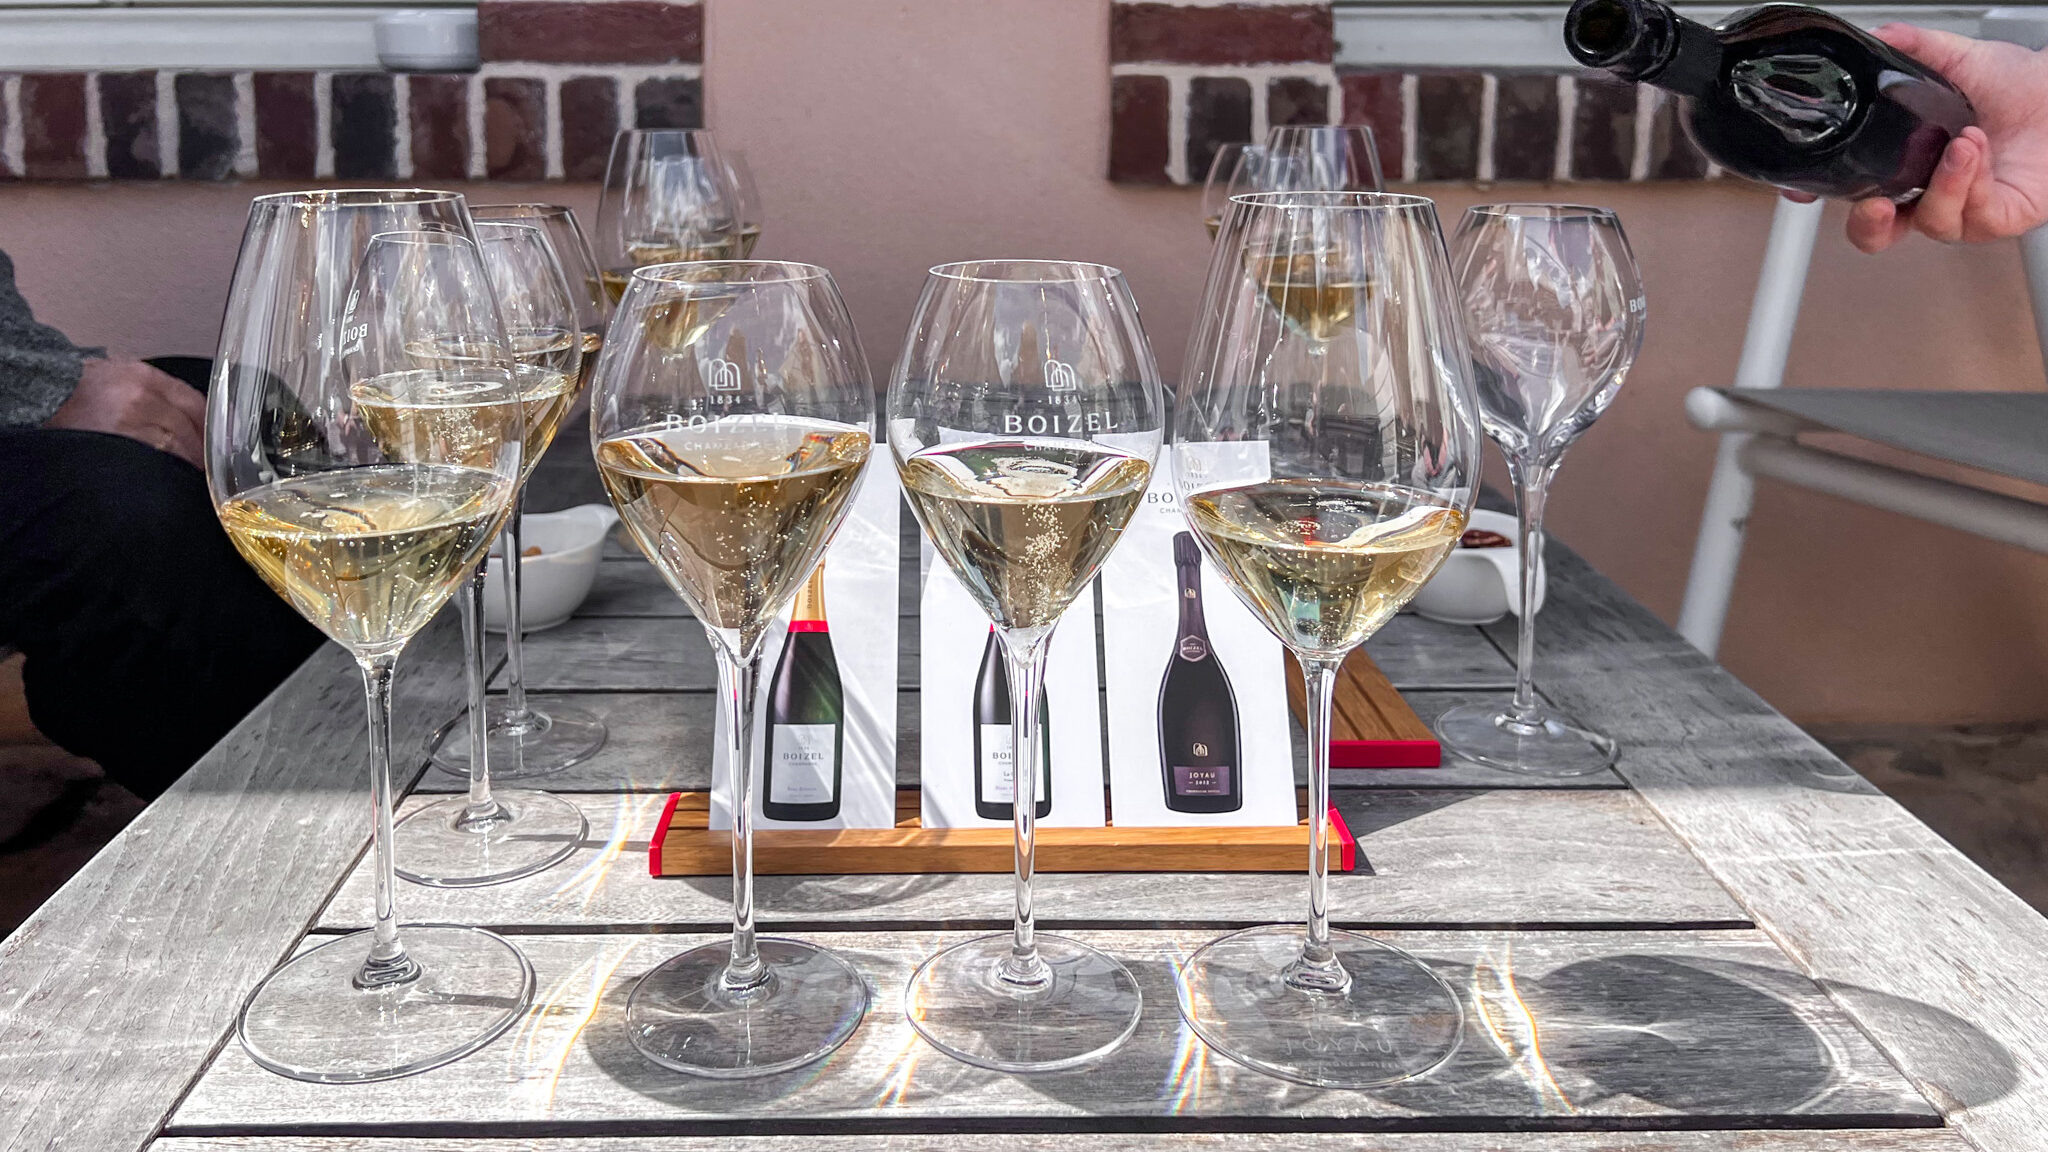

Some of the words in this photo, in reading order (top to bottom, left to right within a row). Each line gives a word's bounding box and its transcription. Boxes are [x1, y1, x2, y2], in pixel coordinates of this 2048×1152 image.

[666, 412, 788, 434] BOIZEL
[1004, 411, 1118, 434] BOIZEL
[783, 752, 824, 760] BOIZEL
[992, 752, 1012, 760] BOI
[1286, 1036, 1392, 1056] JOYAU
